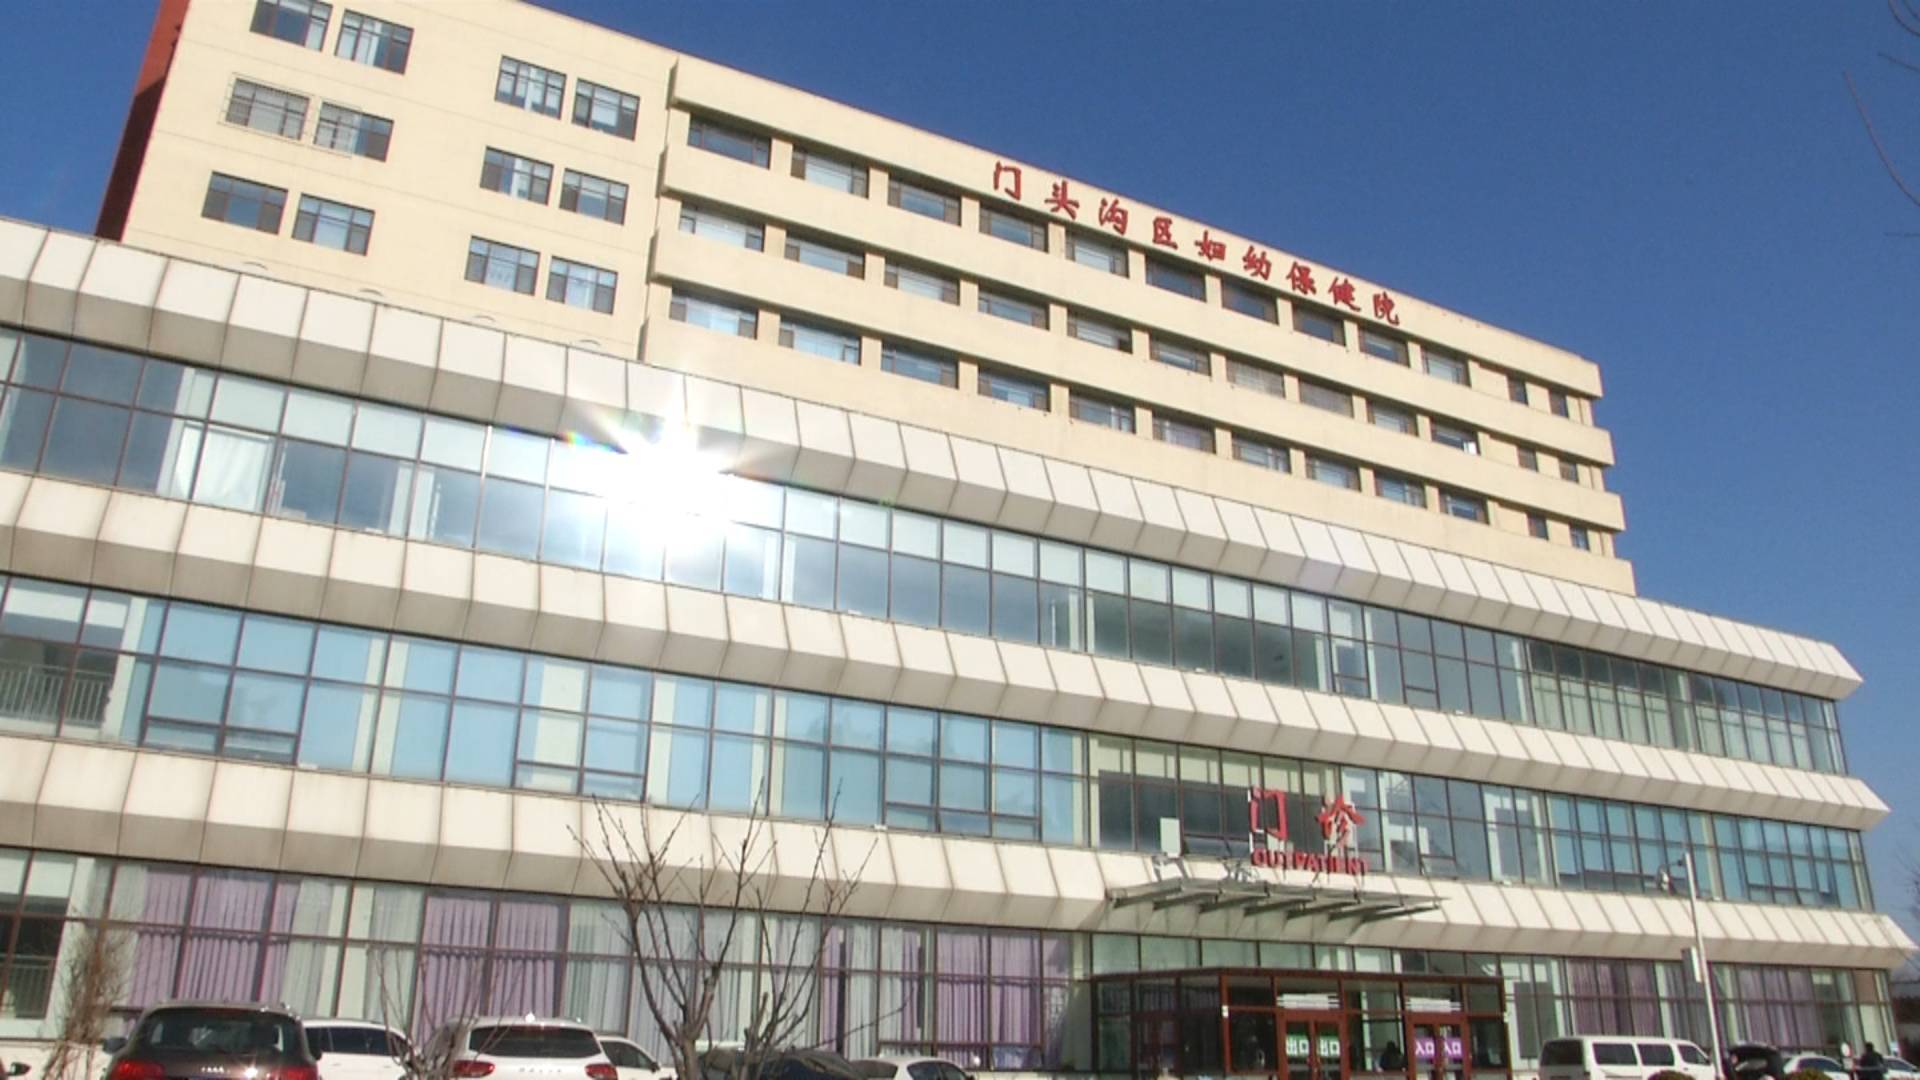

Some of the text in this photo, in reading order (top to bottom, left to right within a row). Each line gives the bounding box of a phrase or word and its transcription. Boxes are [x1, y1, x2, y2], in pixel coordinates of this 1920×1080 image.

[993, 161, 1400, 326] 门头沟区妇幼保健院
[1249, 786, 1366, 850] 门诊
[1251, 848, 1369, 876] OUTPATIENT
[1285, 1036, 1310, 1057] 出口
[1318, 1037, 1341, 1057] 出口
[1415, 1039, 1435, 1056] 入口
[1443, 1039, 1463, 1056] 入口
